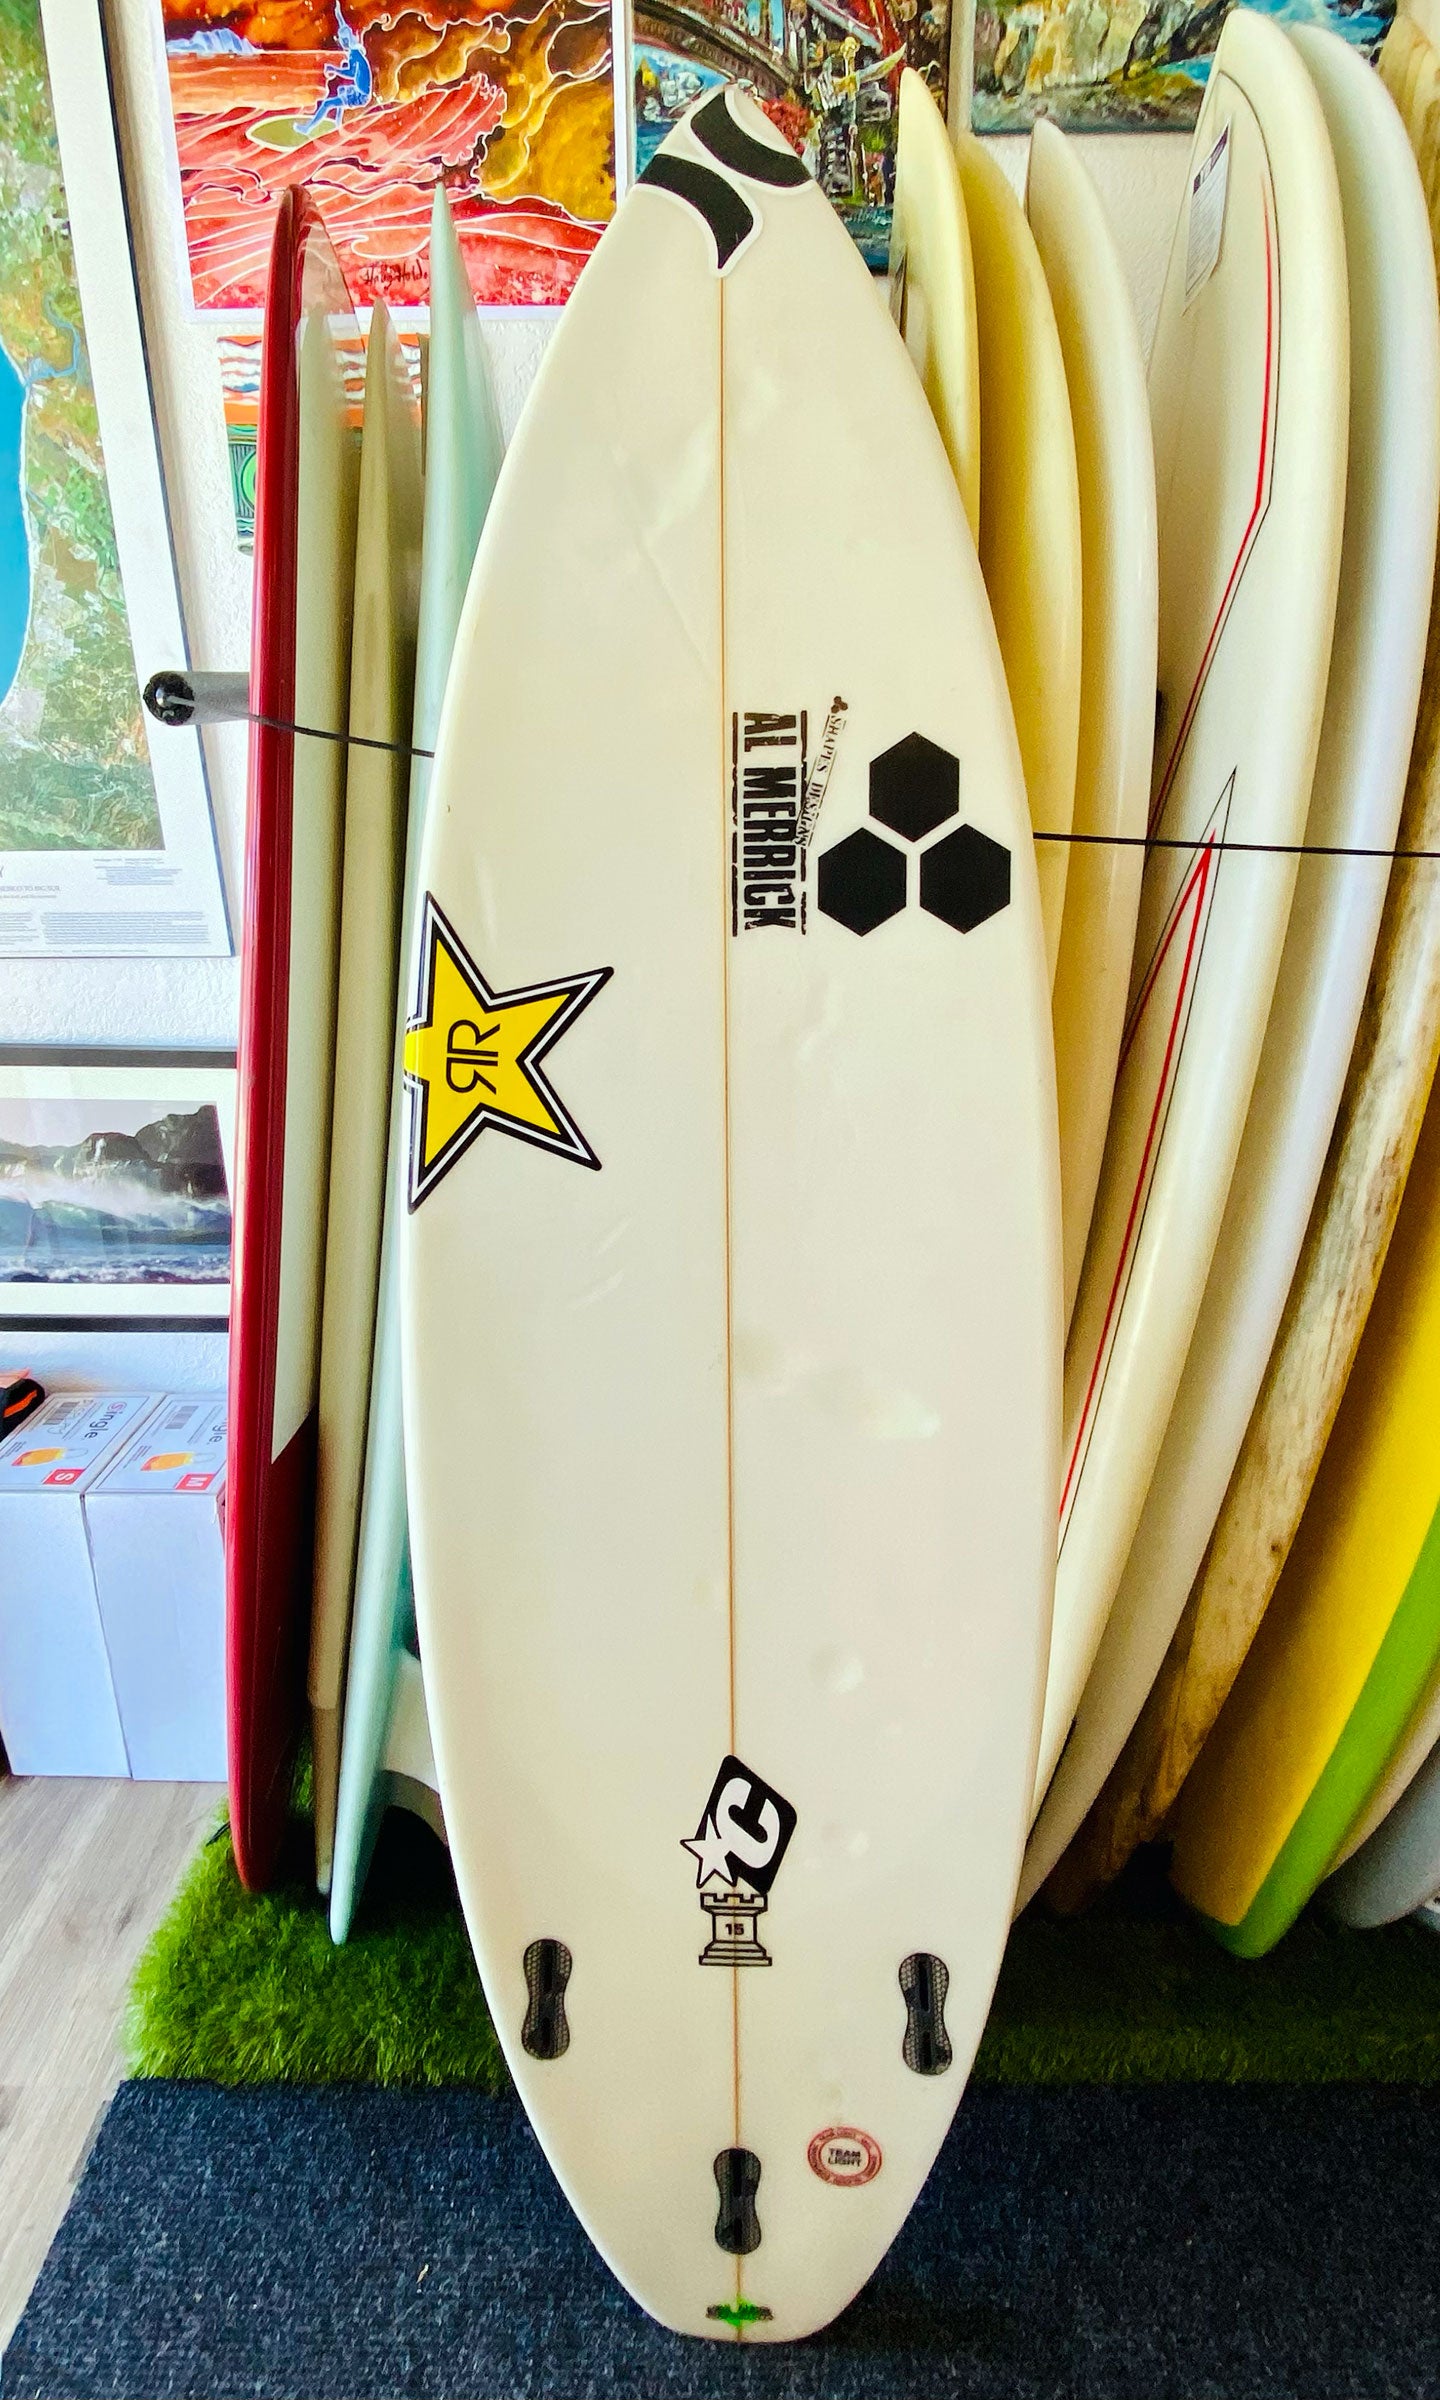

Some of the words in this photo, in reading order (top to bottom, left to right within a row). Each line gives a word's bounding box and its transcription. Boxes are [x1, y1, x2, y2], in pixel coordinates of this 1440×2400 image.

[744, 712, 797, 752] AL
[743, 767, 797, 930] MERRICK
[724, 1923, 745, 1936] 15
[829, 2147, 861, 2157] TEAM
[827, 2156, 862, 2167] LIGHT
